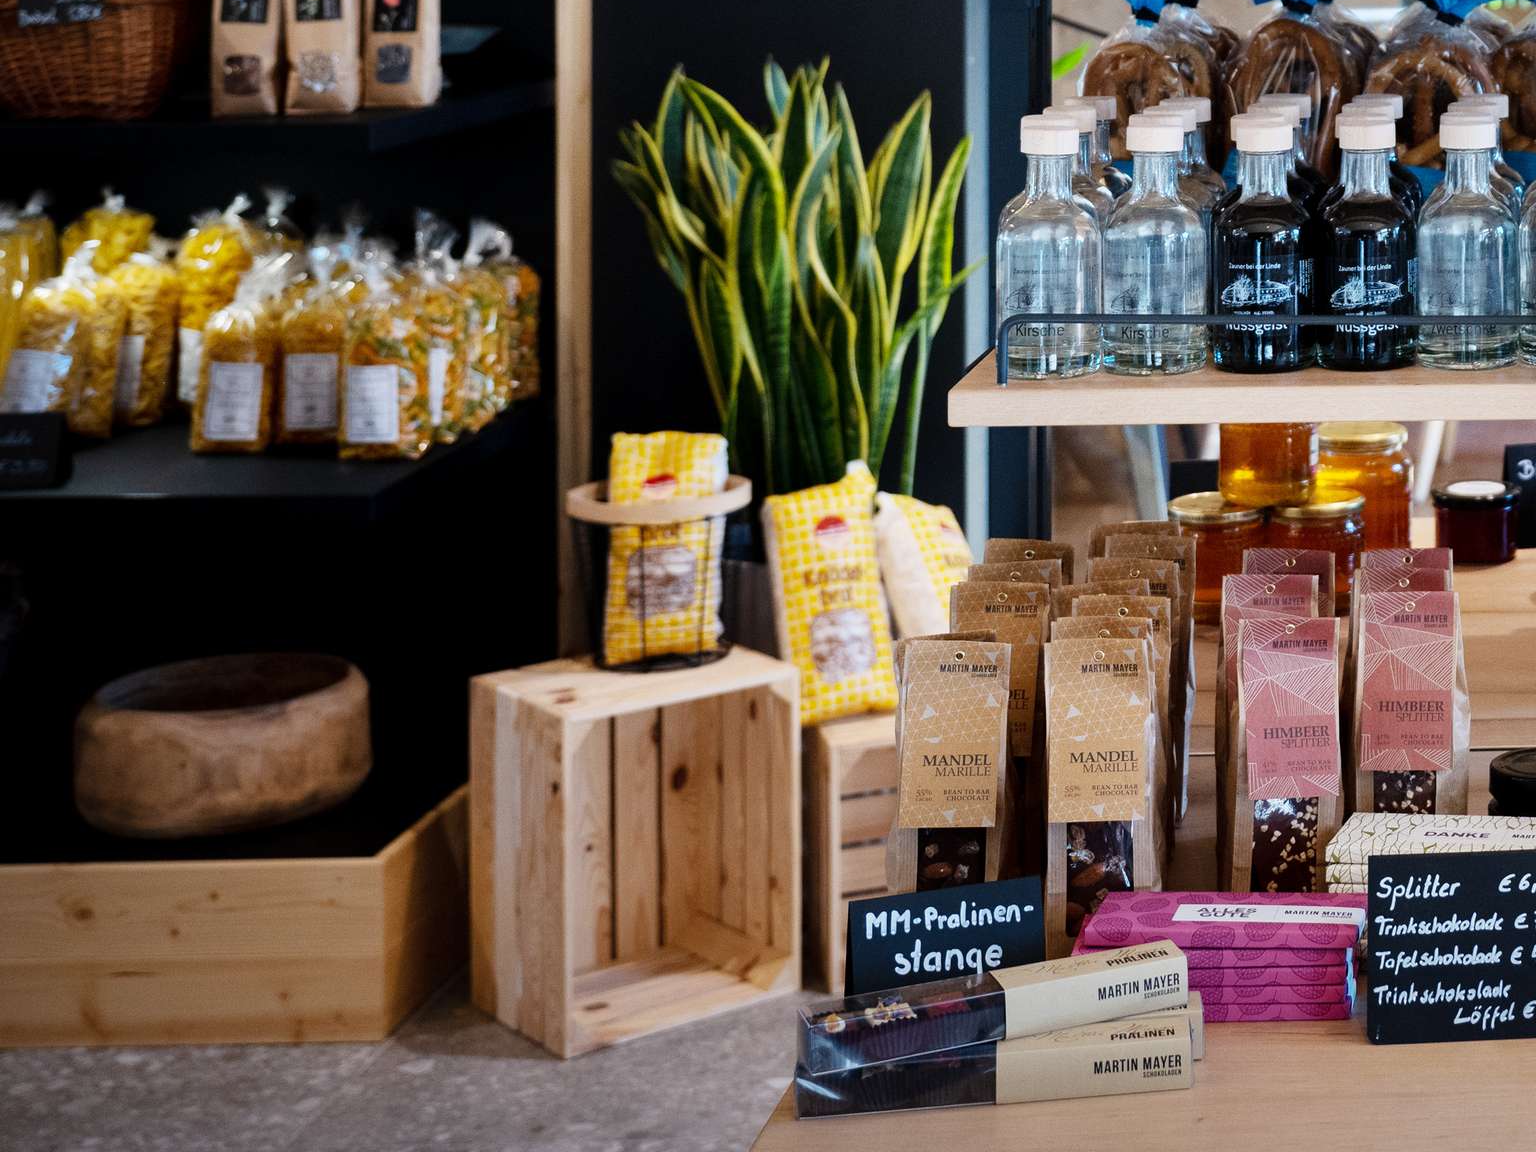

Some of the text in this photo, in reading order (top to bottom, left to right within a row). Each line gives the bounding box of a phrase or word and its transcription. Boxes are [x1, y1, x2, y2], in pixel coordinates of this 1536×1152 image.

[1016, 323, 1064, 337] Kirsche
[1122, 327, 1169, 339] Kirsche
[986, 605, 1038, 614] MARTIN MAYER
[1394, 615, 1448, 624] MARTIN MAYER
[1272, 640, 1301, 649] MARTIN
[940, 663, 998, 673] MARTIN MAYER
[1081, 663, 1138, 673] MARTIN MAYER
[1378, 700, 1444, 712] HIMBEER
[1396, 712, 1444, 722] SPLITTER
[1263, 725, 1329, 739] HIMBEER
[1281, 737, 1330, 749] SPLITTER
[922, 754, 992, 767] MANDEL
[1070, 751, 1137, 763] MANDEL
[935, 767, 991, 777] MARILLE
[1083, 762, 1138, 773] MARILLE
[1424, 831, 1490, 839] DANKE
[1376, 873, 1461, 911] Splitter
[865, 900, 1034, 940] MM-Pralinen-
[1374, 912, 1504, 936] Trinkschokolade
[894, 939, 1003, 976] stange
[1106, 949, 1169, 967] PRALINEN
[1098, 973, 1180, 1001] MARTIN MAYER
[1143, 987, 1180, 999] SCHOKOLADEN
[1453, 1002, 1515, 1031] Löffel
[1110, 1028, 1176, 1041] PRALINEN
[1094, 1054, 1182, 1074] MARTIN MAYER
[1143, 1069, 1182, 1078] SCHOKOLADEN
